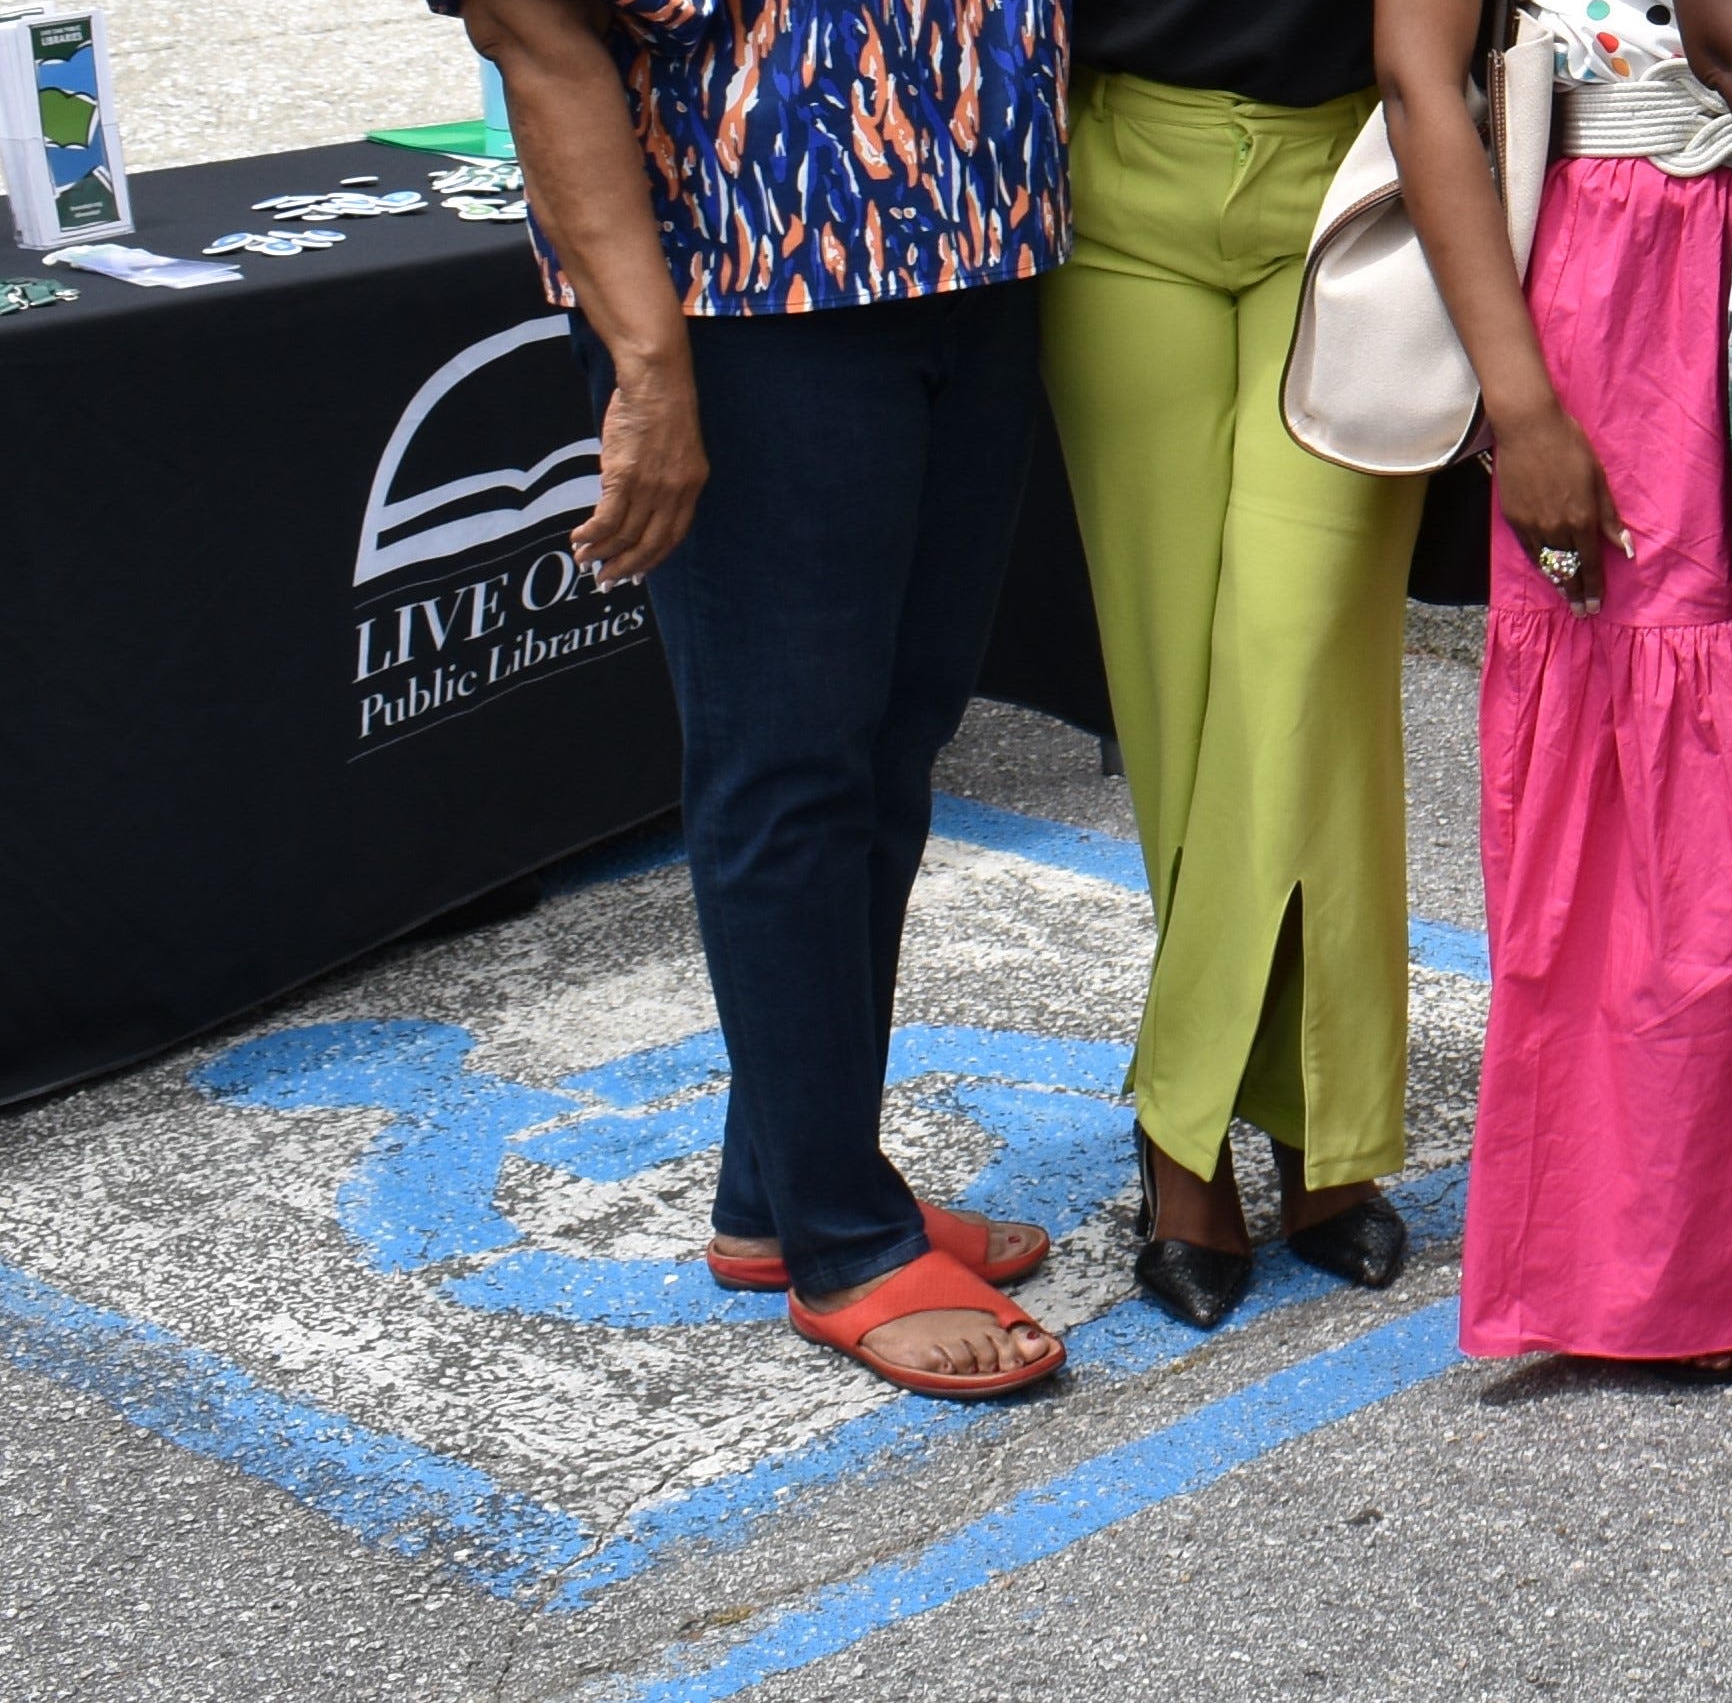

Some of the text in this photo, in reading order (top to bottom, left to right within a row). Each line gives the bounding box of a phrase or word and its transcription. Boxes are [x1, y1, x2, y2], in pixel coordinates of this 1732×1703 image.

[352, 573, 508, 684] LIVE
[359, 604, 645, 739] Public Libraries
